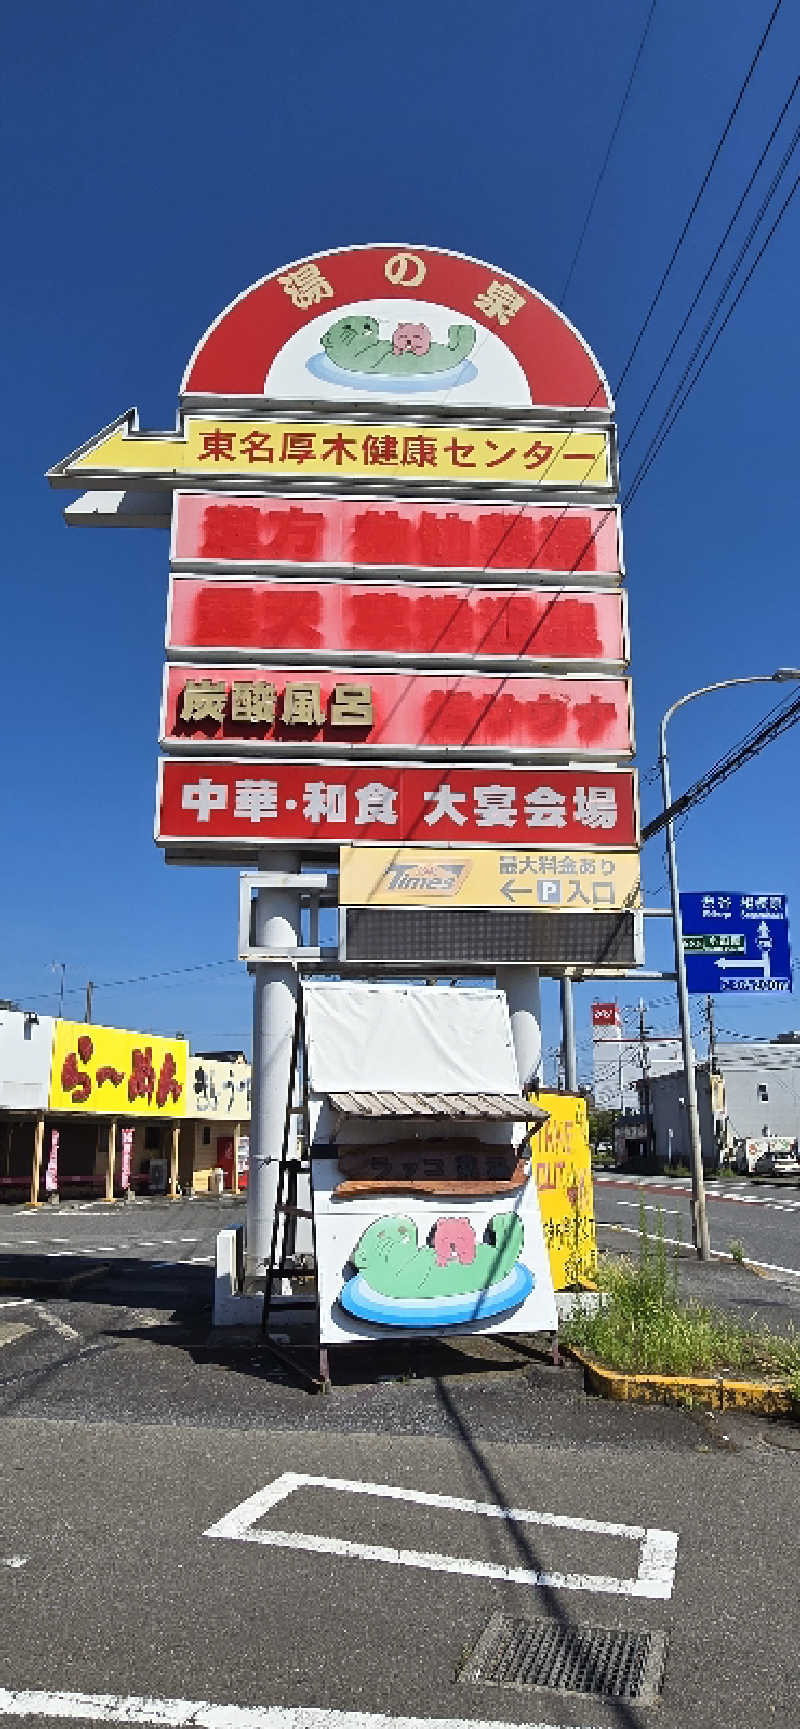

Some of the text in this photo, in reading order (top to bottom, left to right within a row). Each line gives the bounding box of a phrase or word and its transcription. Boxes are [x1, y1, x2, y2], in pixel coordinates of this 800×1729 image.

[278, 252, 527, 326] 湯の泉
[197, 428, 596, 470] 東名厚木健康センター
[179, 678, 374, 726] 炭酸風呂
[423, 784, 618, 829] 大宴会場
[387, 864, 456, 891] Times
[499, 855, 616, 875] 最大料金あり
[566, 880, 616, 904] 入口
